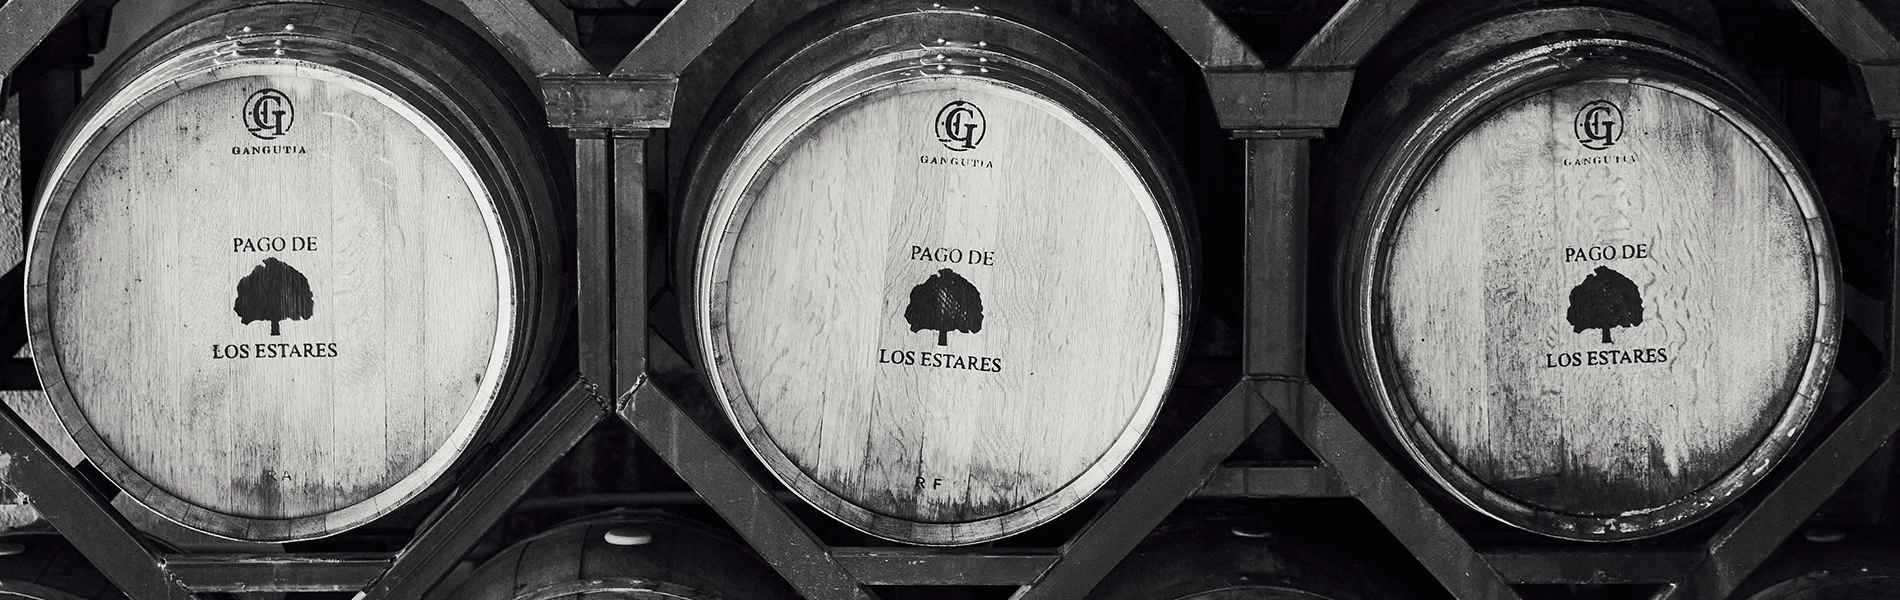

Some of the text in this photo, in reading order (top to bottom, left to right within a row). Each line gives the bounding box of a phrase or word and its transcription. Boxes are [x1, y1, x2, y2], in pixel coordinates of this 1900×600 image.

[231, 145, 306, 155] GANGUTIA
[233, 236, 318, 253] PAGO DE
[1565, 243, 1648, 263] PAGO DE
[910, 245, 995, 267] PAGO DE
[212, 342, 338, 359] LOS ESTARES
[879, 348, 1002, 373] LOS ESTARES
[1546, 347, 1668, 369] LOS ESTARES
